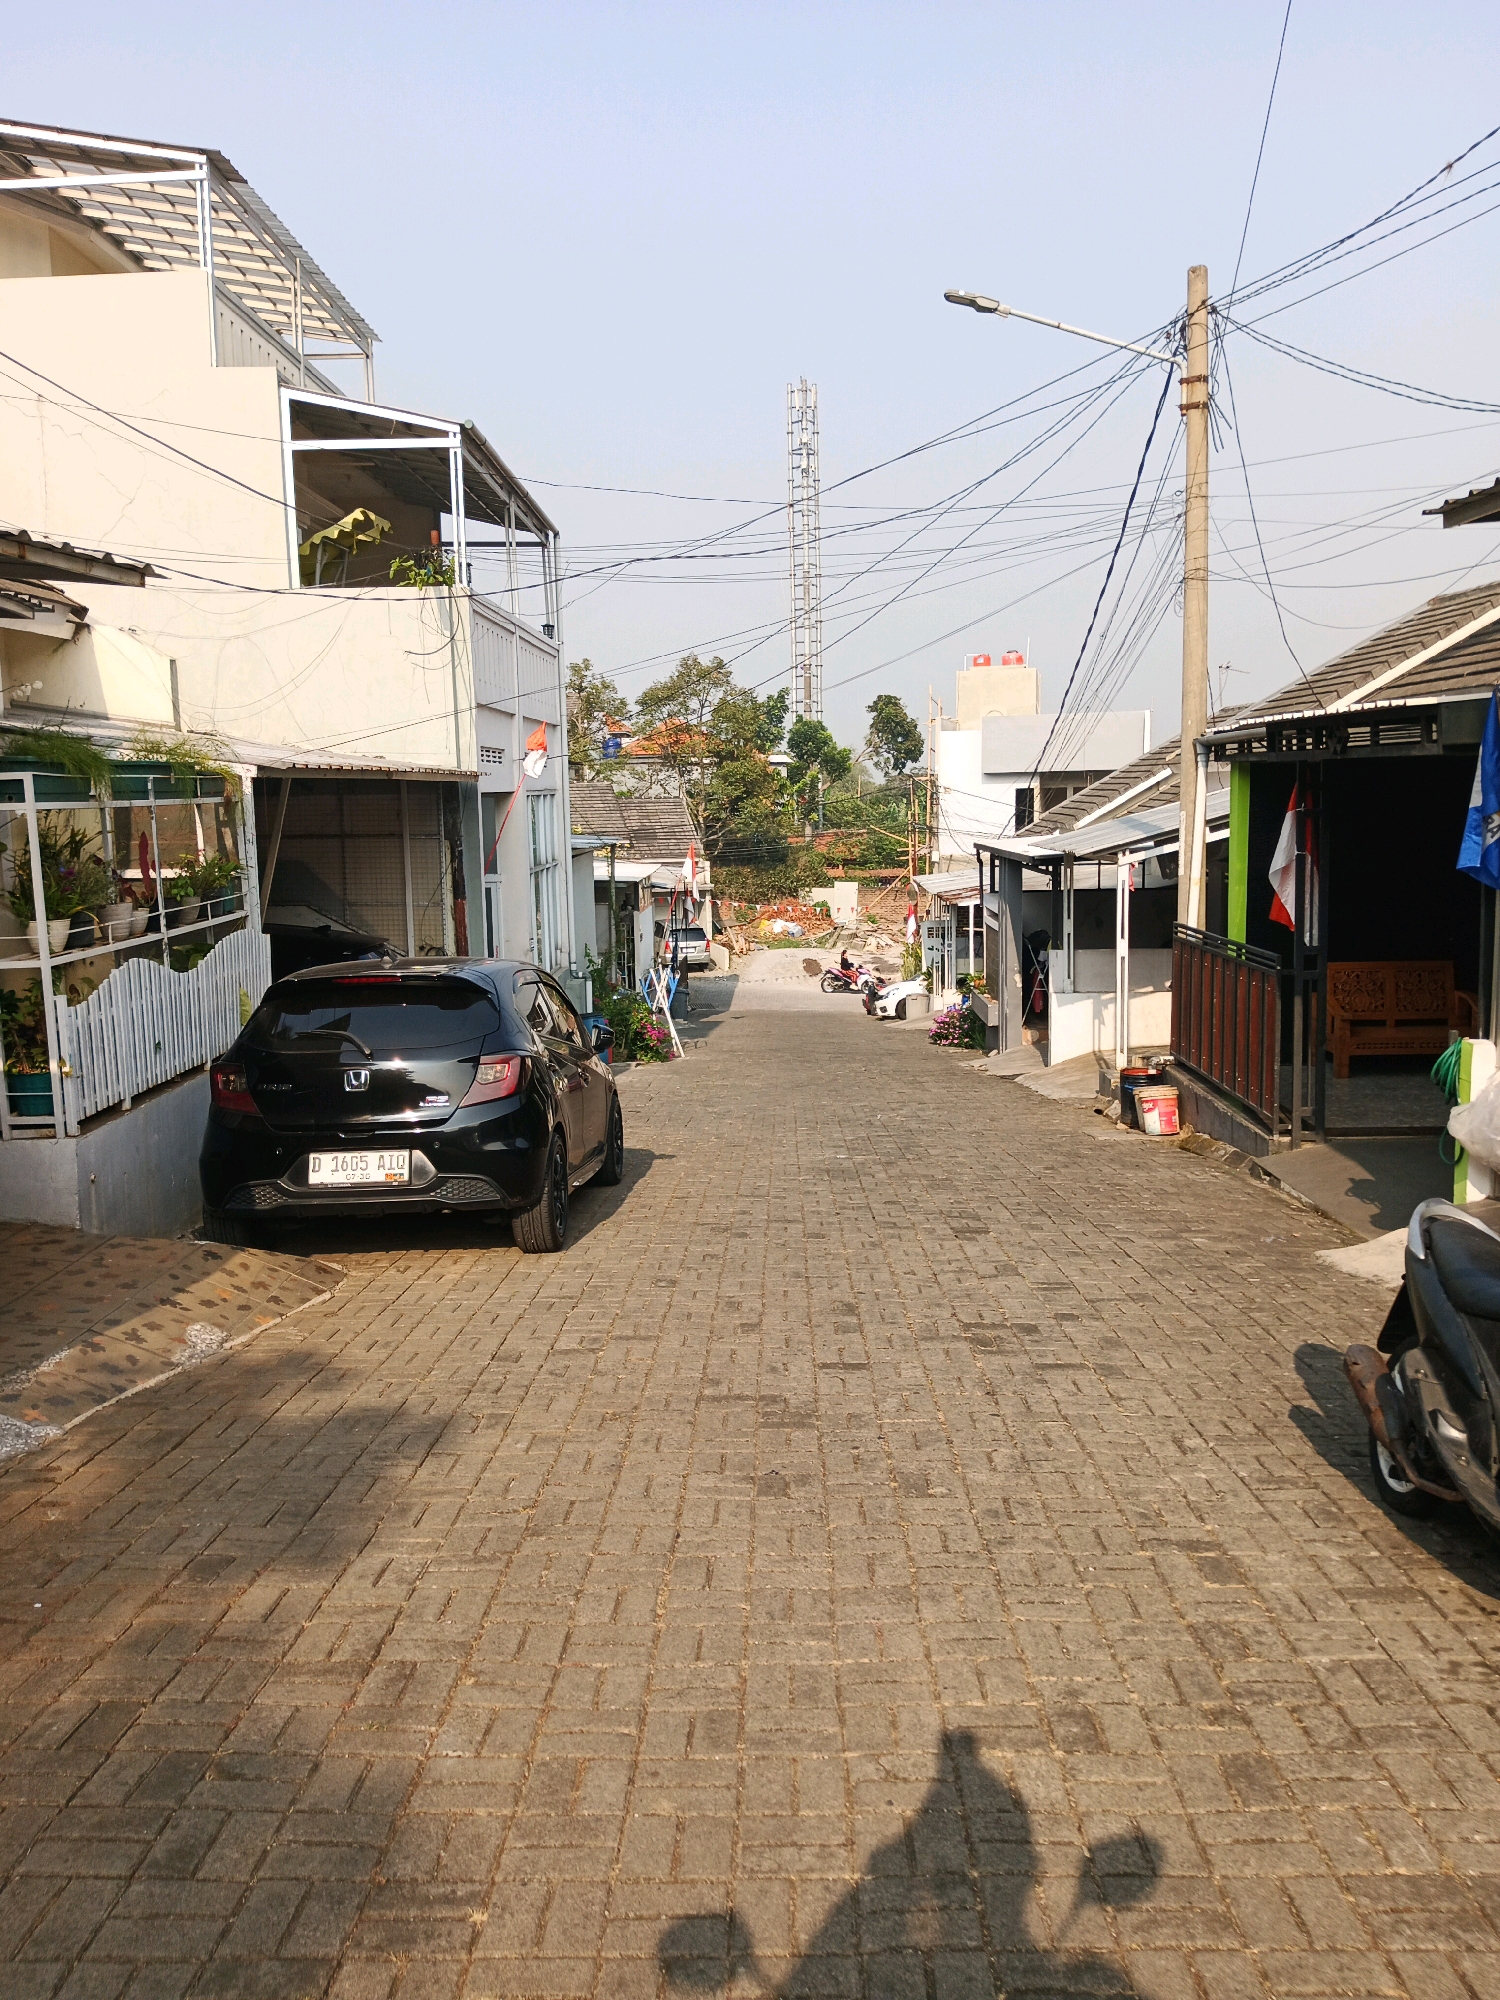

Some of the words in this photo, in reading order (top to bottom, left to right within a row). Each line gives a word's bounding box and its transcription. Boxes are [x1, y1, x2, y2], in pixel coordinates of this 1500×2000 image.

[312, 1156, 321, 1173] D
[331, 1155, 369, 1173] 1605
[377, 1154, 406, 1171] AIQ
